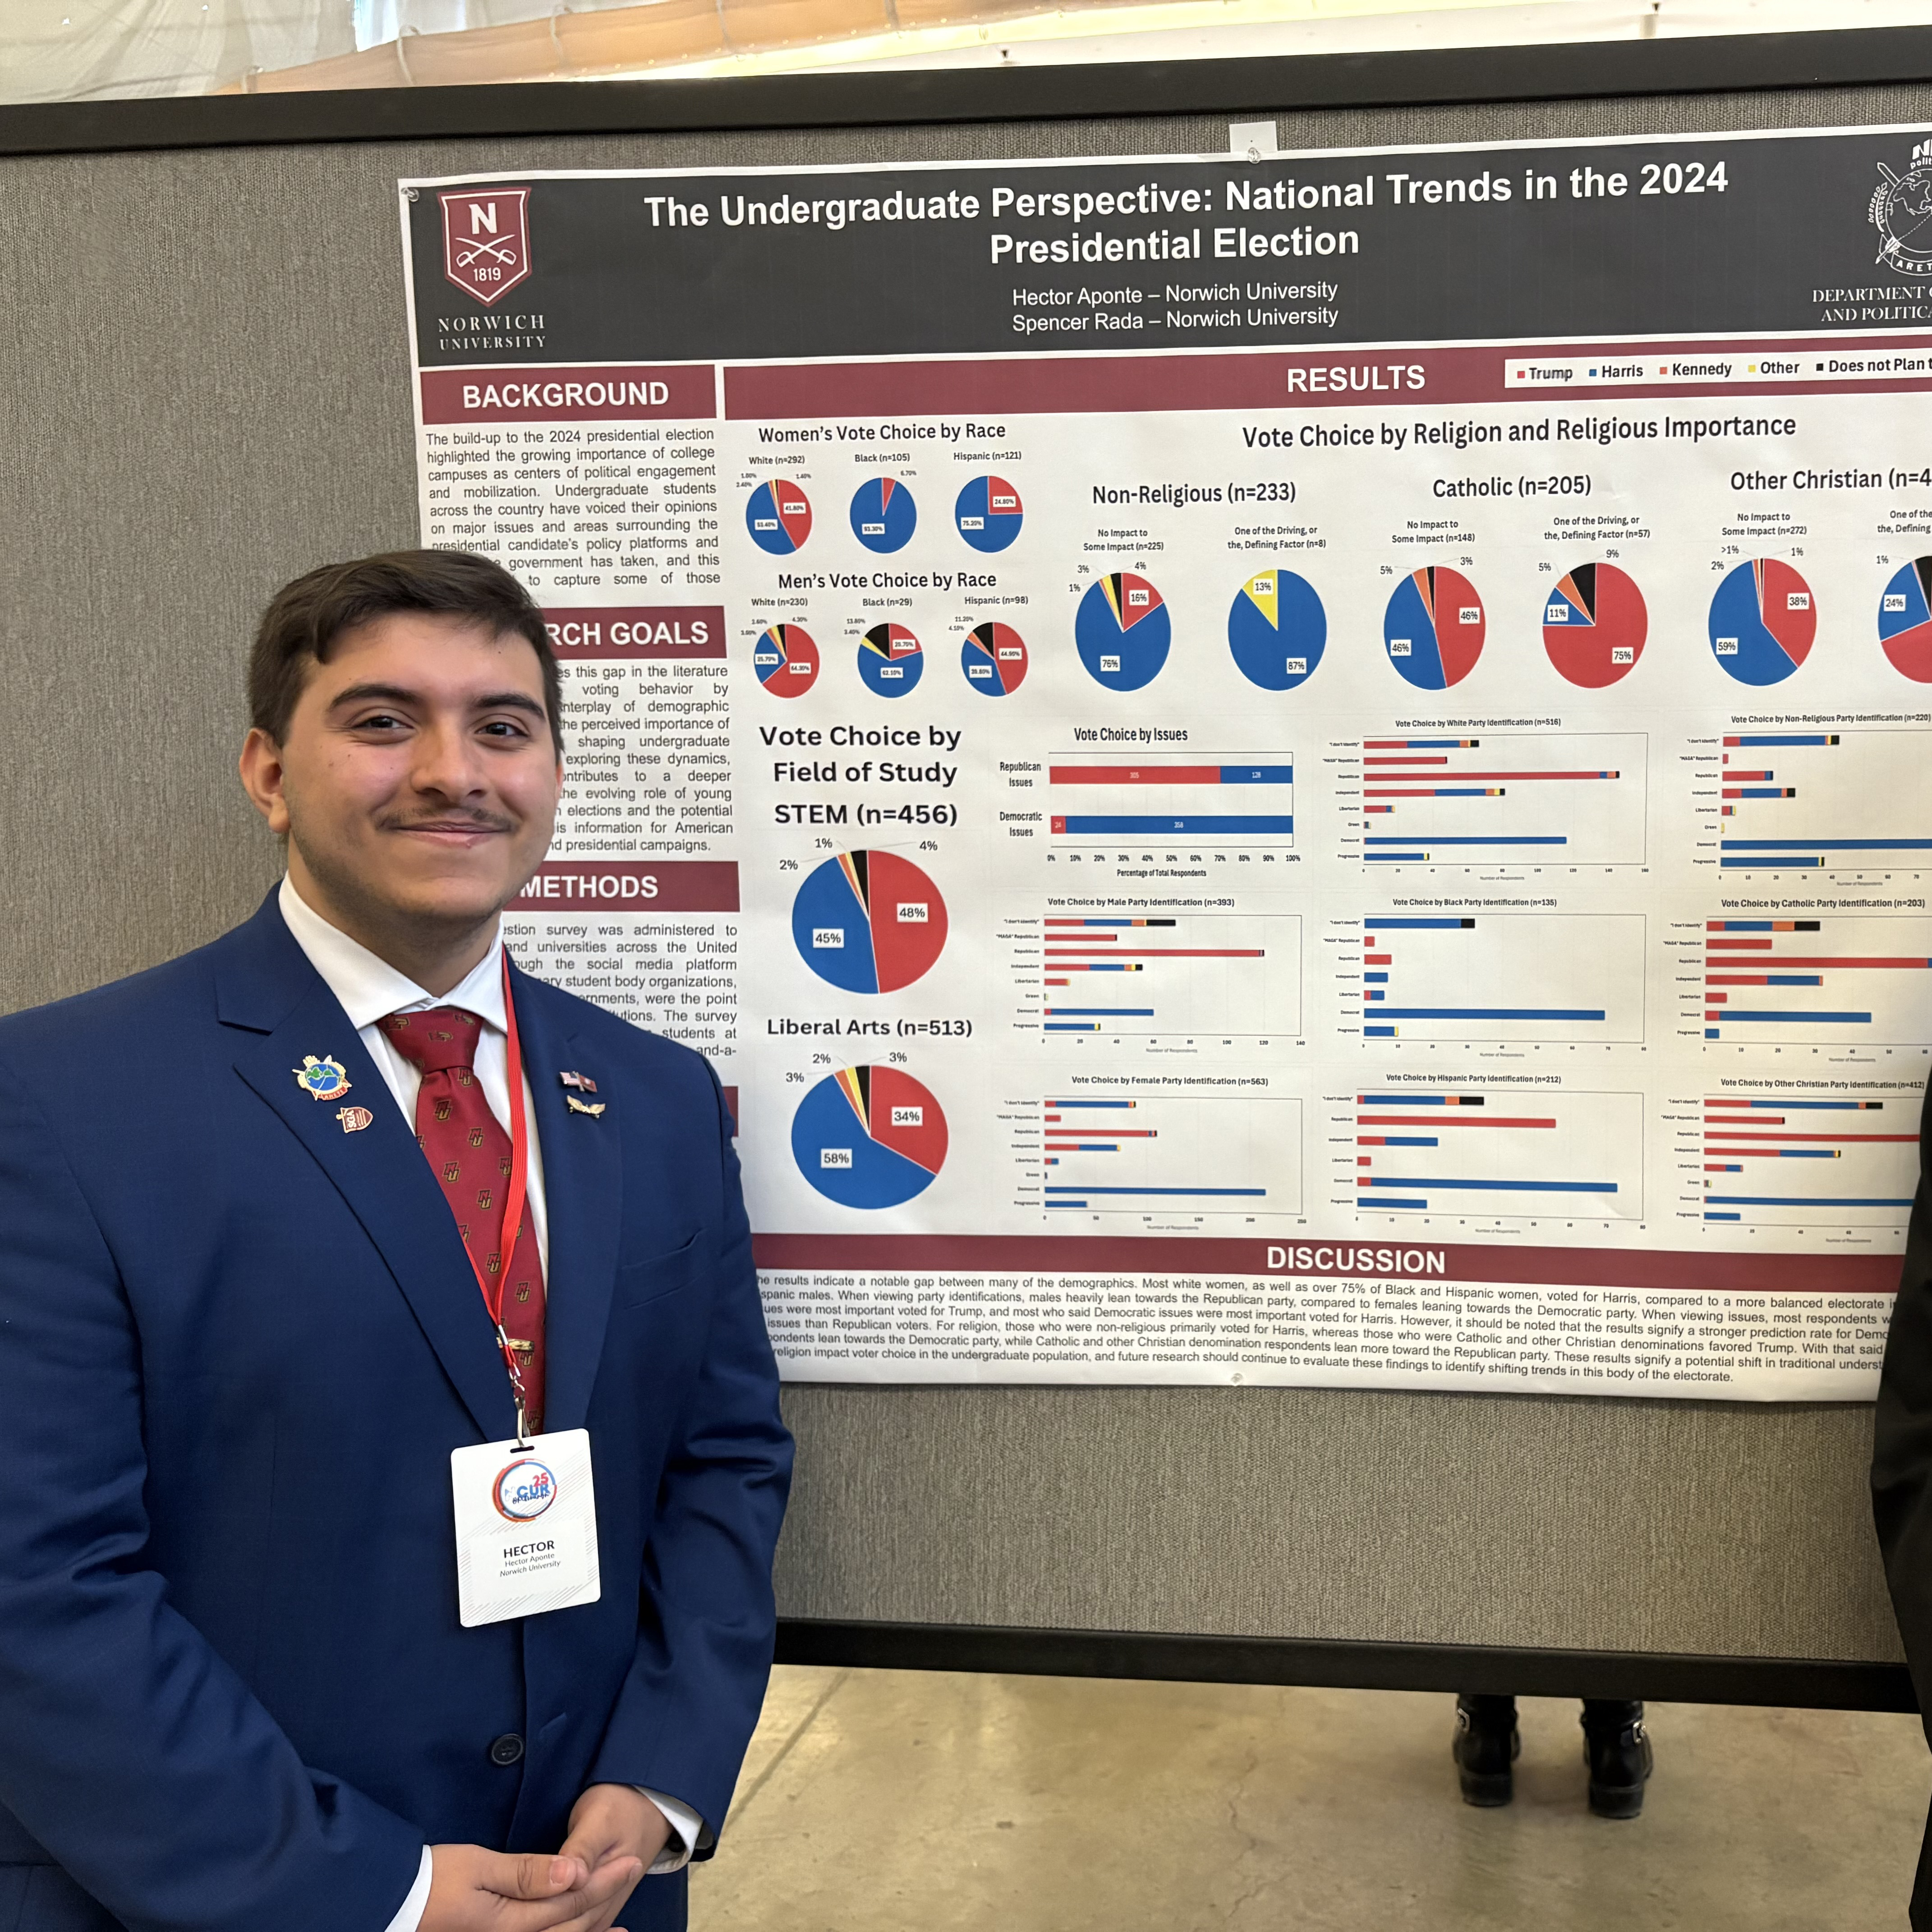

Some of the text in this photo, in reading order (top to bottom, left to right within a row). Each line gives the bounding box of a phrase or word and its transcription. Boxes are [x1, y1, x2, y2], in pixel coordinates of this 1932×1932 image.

[644, 161, 1729, 230] The Undergraduate Perspective: National Trends in the 2024
[469, 202, 497, 235] N
[991, 225, 1358, 264] Presidential Election
[1896, 260, 1932, 272] ARET
[473, 267, 501, 281] 1819
[1013, 281, 1338, 308] Hector Aponte Norwich University
[1813, 286, 1926, 303] DEPARTMENT
[1013, 307, 1339, 336] Spencer Rada Norwich University
[1821, 306, 1932, 322] AND POLITIC
[438, 315, 544, 332] NORWICH
[440, 336, 546, 350] UNIVERSITY
[1602, 364, 1643, 378] Harris
[1673, 362, 1732, 378] Kennedy
[1760, 361, 1800, 374] Other
[1829, 358, 1924, 373] Does not Plan
[1288, 365, 1425, 392] RESULTS
[1529, 367, 1573, 382] Trump
[463, 382, 669, 409] BACKGROUND
[425, 428, 714, 446] The build-up to the 2024 presidential election
[836, 426, 875, 441] Vote
[880, 423, 936, 440] Choice
[941, 423, 961, 442] by
[966, 423, 1006, 438] Race
[1242, 416, 1796, 451] Vote Choice by Religion and Religious Importance
[427, 446, 715, 466] highlighted the growing importance of college
[748, 456, 773, 465] White
[855, 454, 878, 462] Black
[953, 451, 990, 462] Hispanic
[1433, 474, 1591, 498] Catholic (n=205)
[1731, 468, 1932, 492] Other Christian (n=4
[1093, 482, 1296, 508] Non-Religious (n=233)
[1098, 529, 1109, 537] No
[1110, 529, 1138, 539] Impact
[1083, 543, 1106, 551] Some
[1107, 543, 1135, 553] Impact
[610, 621, 708, 645] GOALS
[759, 725, 961, 751] Vote Choice by
[1074, 727, 1188, 744] Vote Choice by Issues
[566, 752, 730, 768] exploring these dynamics,
[1000, 761, 1041, 773] Republican
[774, 761, 957, 788] Field of Study
[1009, 777, 1033, 787] Issues
[775, 804, 957, 827] STEM (n=456)
[999, 811, 1042, 821] Democratic
[1009, 827, 1033, 837] Issues
[815, 838, 833, 848] 1%
[919, 841, 938, 851] 4%
[779, 859, 798, 870] 2%
[1117, 869, 1148, 879] Percentage
[1155, 869, 1169, 877] Total
[1170, 869, 1207, 879] Respondents
[520, 875, 658, 898] METHODS
[1096, 898, 1106, 907] by
[1107, 898, 1127, 906] Male
[1128, 898, 1148, 907] Party
[1721, 899, 1739, 907] Vote
[1740, 899, 1769, 907] Choice
[1771, 899, 1780, 909] by
[1781, 899, 1815, 907] Catholic
[1817, 899, 1837, 909] Party
[1839, 899, 1892, 907] Identification
[899, 907, 925, 918] 48%
[547, 923, 737, 938] survey was administered to
[815, 933, 841, 943] 45%
[768, 1018, 972, 1038] Liberal Arts (n=513)
[894, 1111, 920, 1122] 34%
[824, 1153, 849, 1164] 58%
[1267, 1246, 1445, 1274] DISCUSSION
[774, 1275, 984, 1289] results indicate a notable gap between
[1645, 1295, 1885, 1309] compared to a more balanced electorate
[503, 1540, 555, 1559] HECTOR
[505, 1553, 555, 1567] Hector Aponte
[500, 1560, 561, 1578] Norwich University
